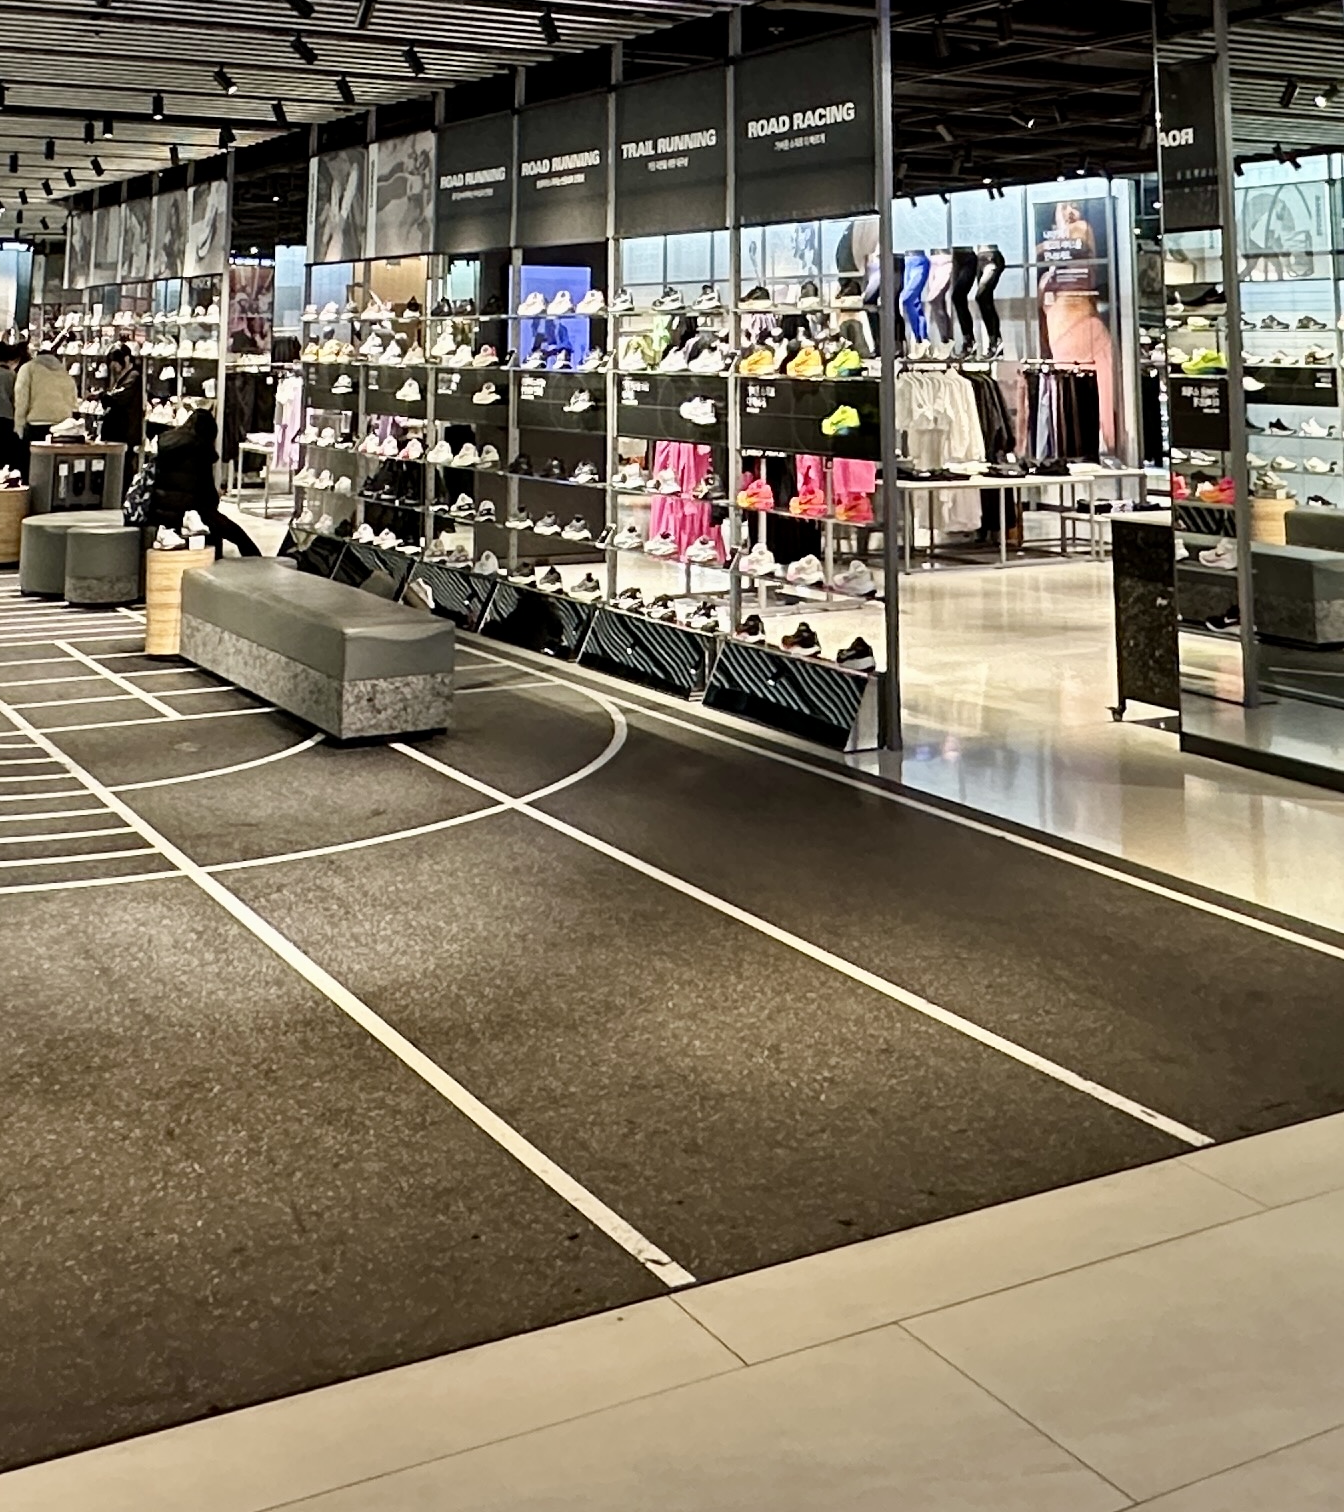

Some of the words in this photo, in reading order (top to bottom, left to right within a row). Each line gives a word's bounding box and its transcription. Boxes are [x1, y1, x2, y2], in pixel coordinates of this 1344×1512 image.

[747, 115, 790, 138] ROAD
[792, 101, 855, 131] RACING
[621, 139, 655, 159] TRAIL
[657, 129, 717, 154] RUNNING
[521, 158, 550, 176] ROAD
[551, 149, 600, 172] RUNNING
